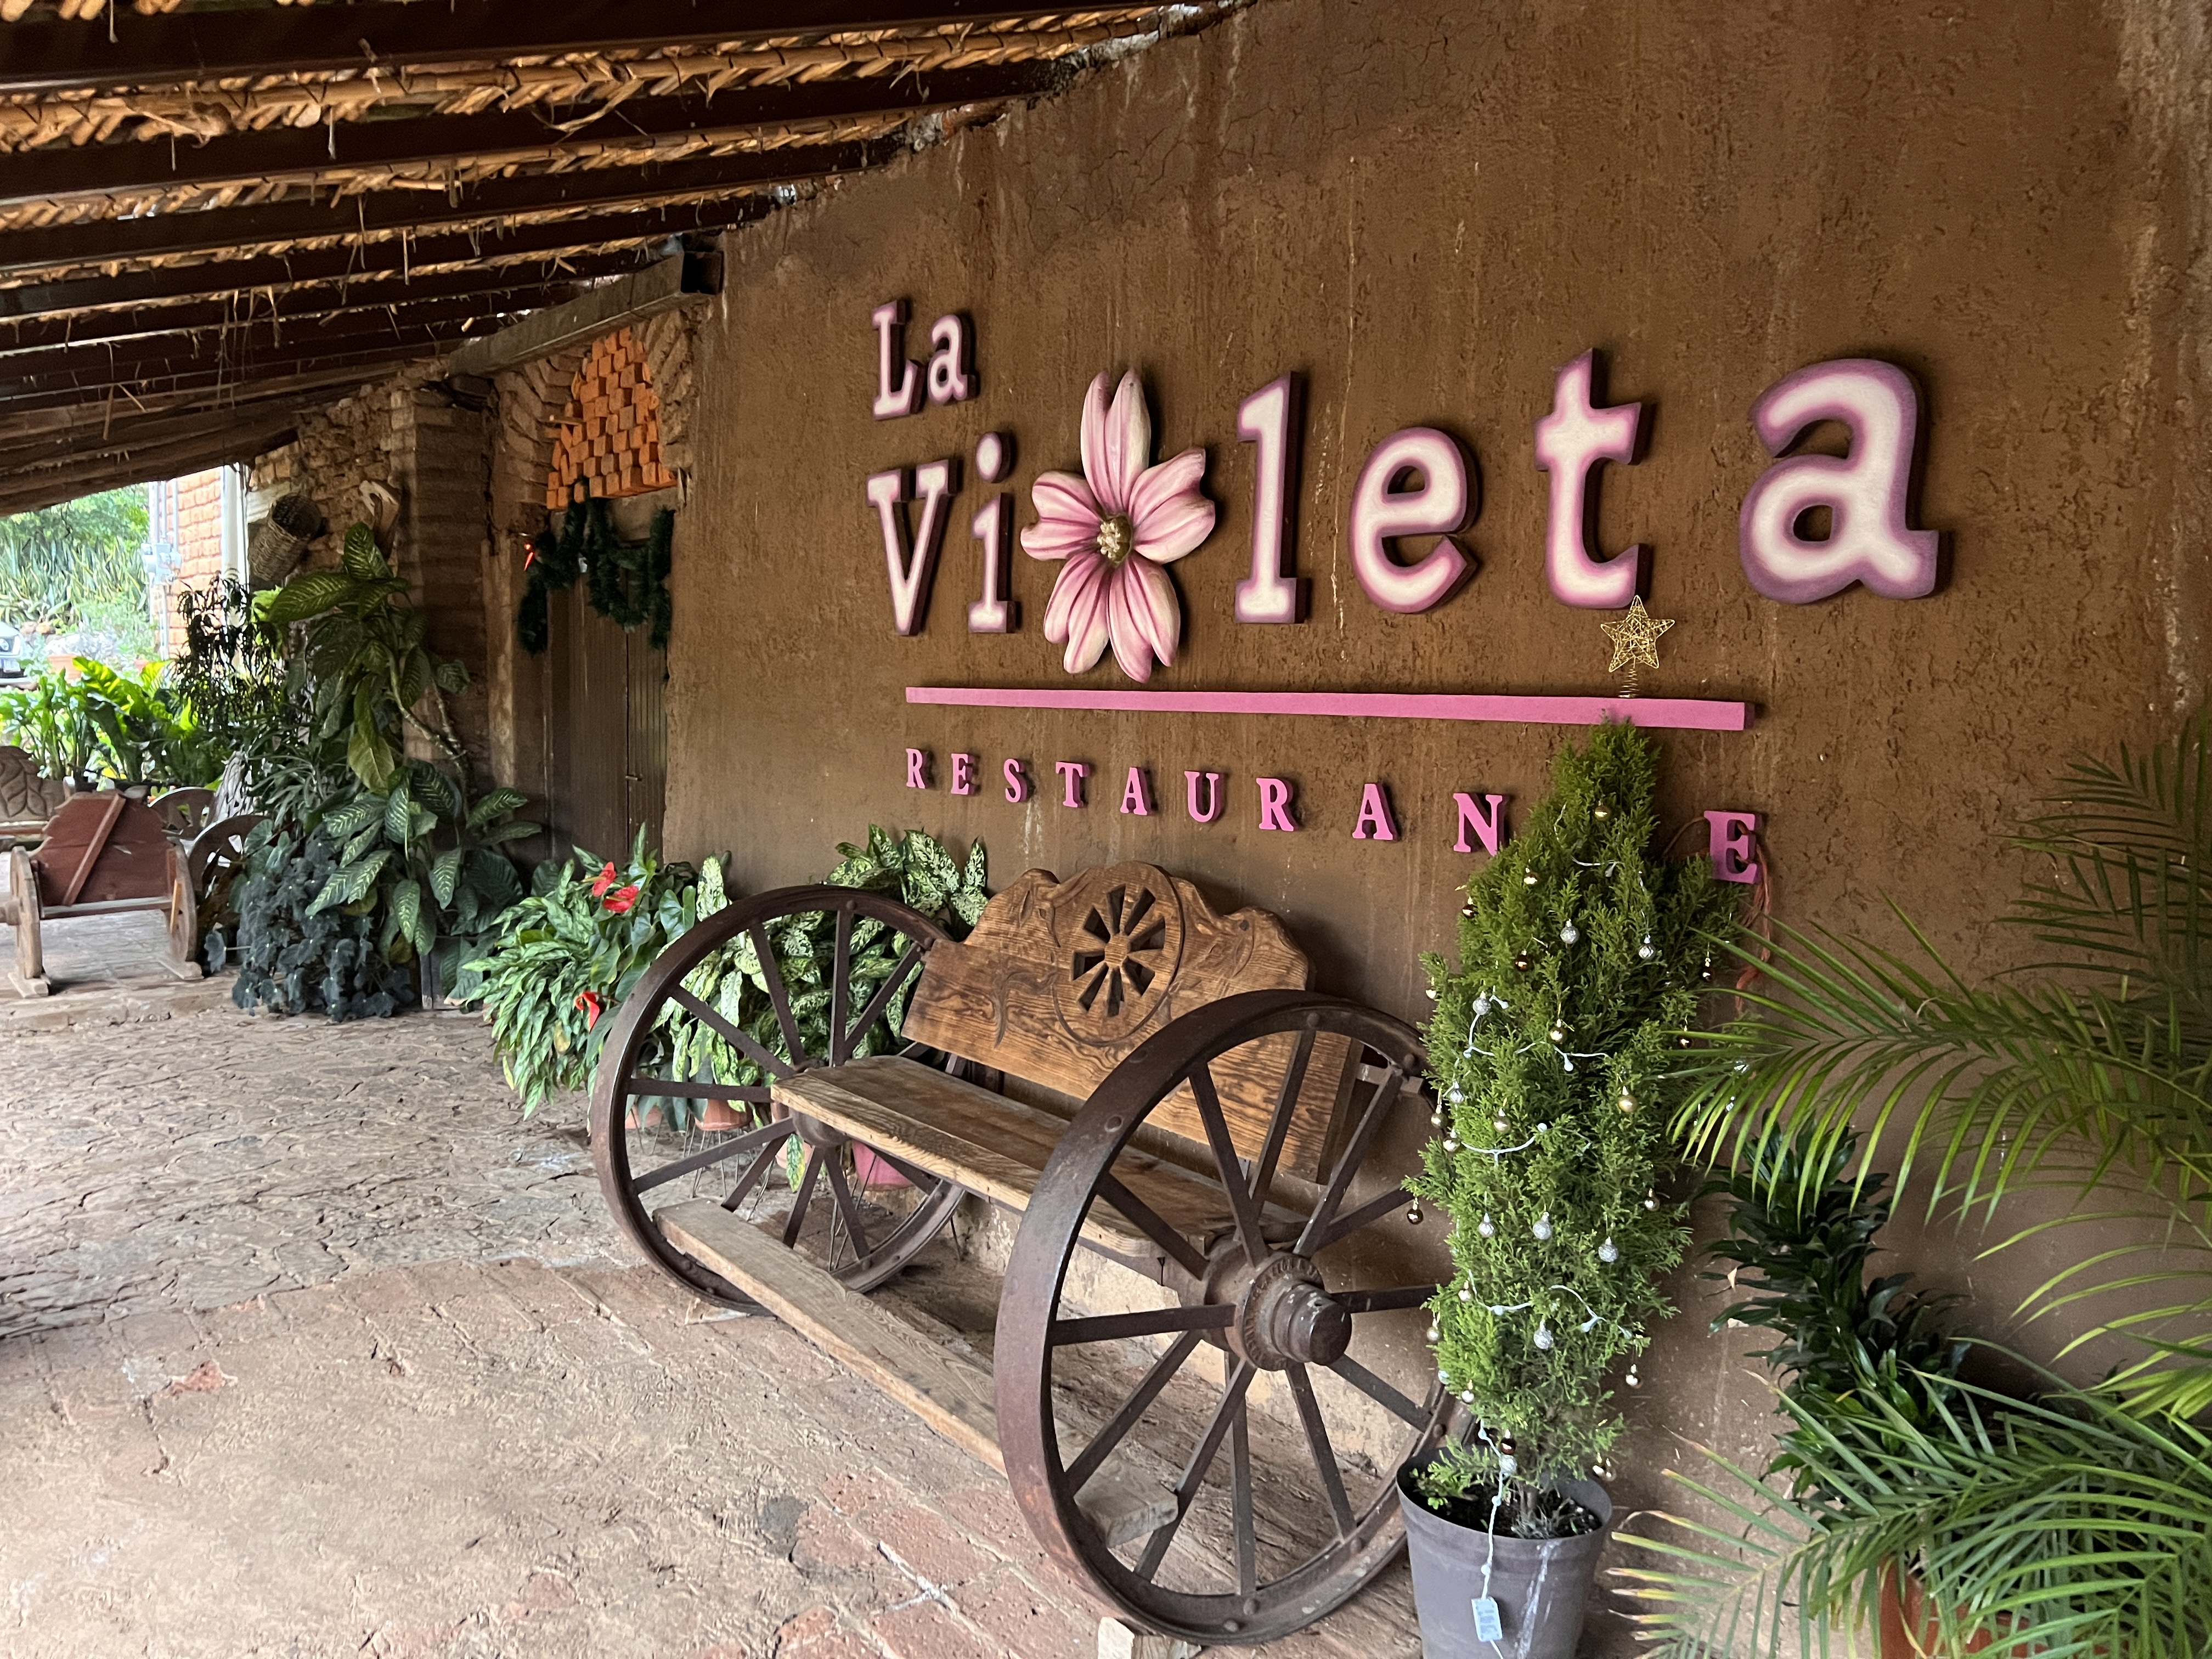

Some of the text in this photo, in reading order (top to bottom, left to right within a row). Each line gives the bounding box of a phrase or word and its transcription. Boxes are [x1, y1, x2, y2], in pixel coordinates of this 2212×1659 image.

[872, 300, 977, 420] La
[867, 347, 1945, 636] Vileta
[906, 747, 1760, 884] RESTAURANE
